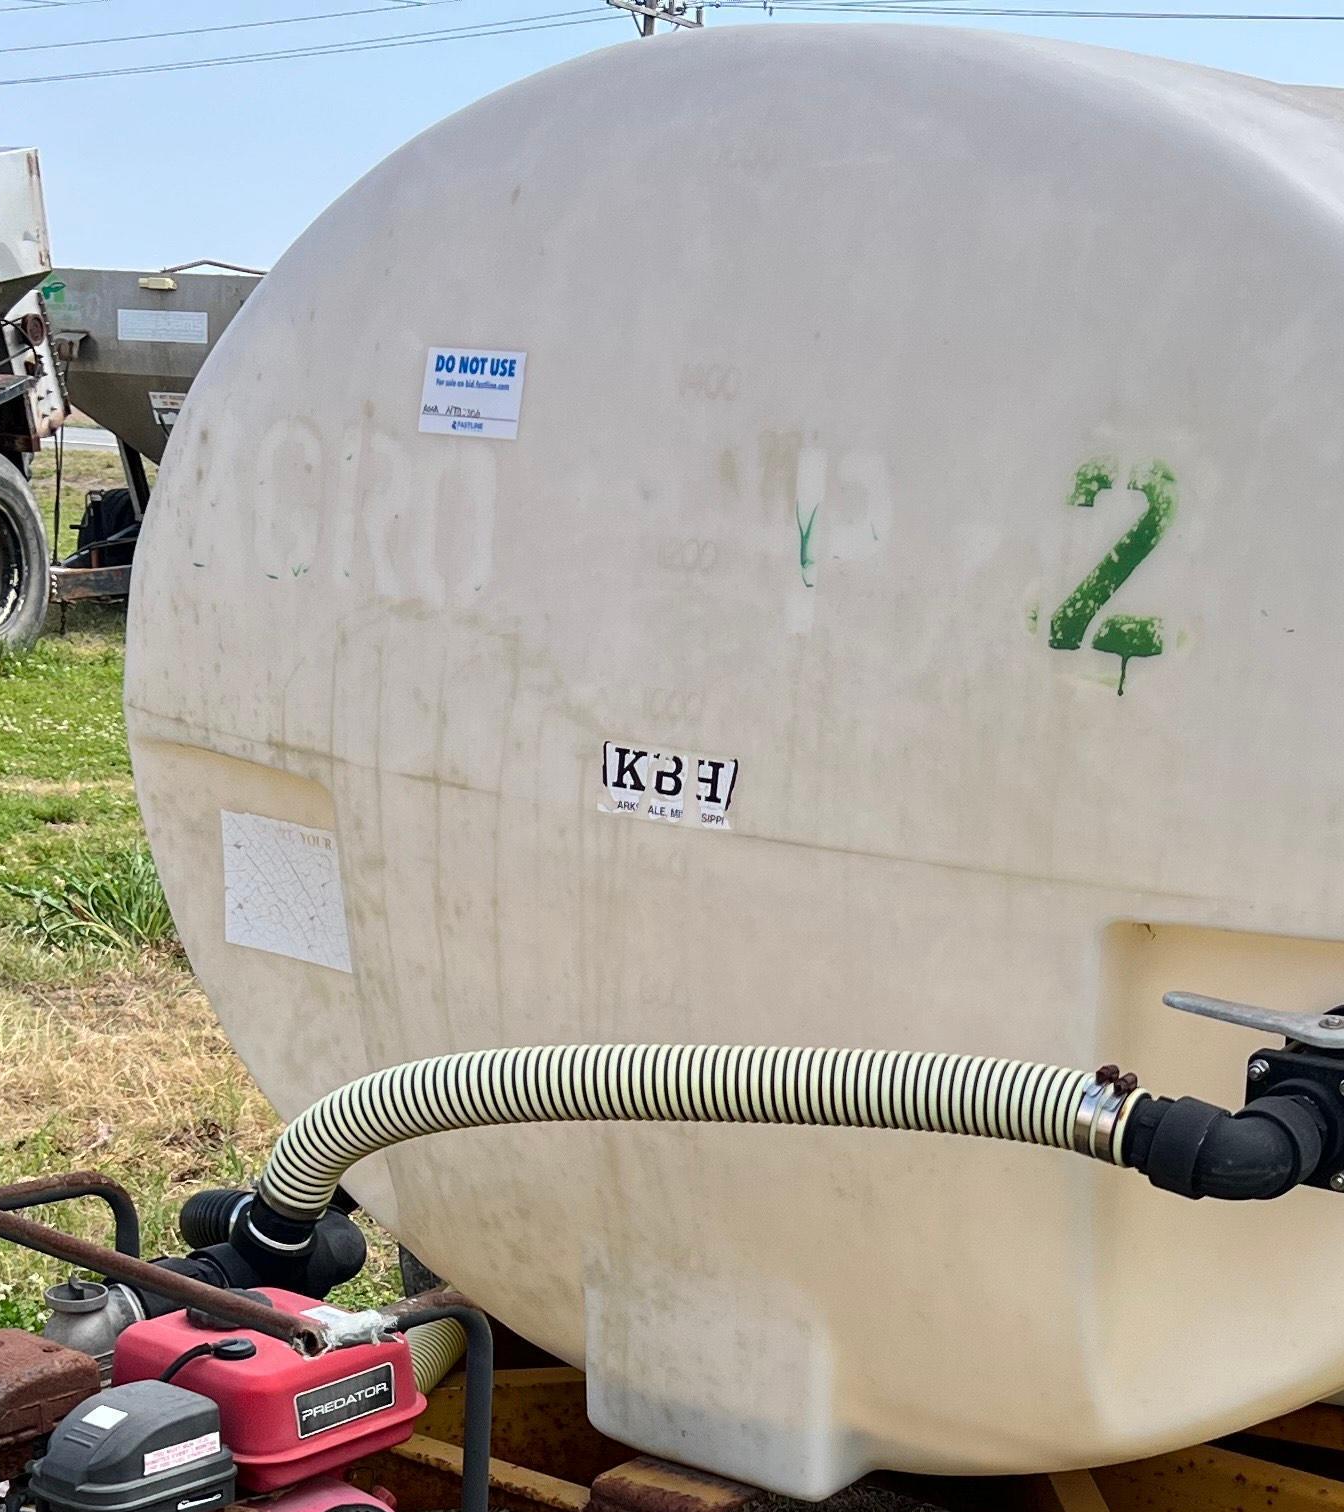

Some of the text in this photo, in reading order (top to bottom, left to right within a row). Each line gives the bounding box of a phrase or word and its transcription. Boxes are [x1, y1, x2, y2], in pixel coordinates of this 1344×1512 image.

[435, 355, 517, 377] DO NOT USE
[436, 378, 444, 386] For
[457, 421, 483, 430] FASTLINE
[1049, 458, 1177, 658] 2
[612, 747, 725, 804] KBH
[299, 831, 332, 850] YOUR
[301, 1382, 389, 1421] PREDATOR
